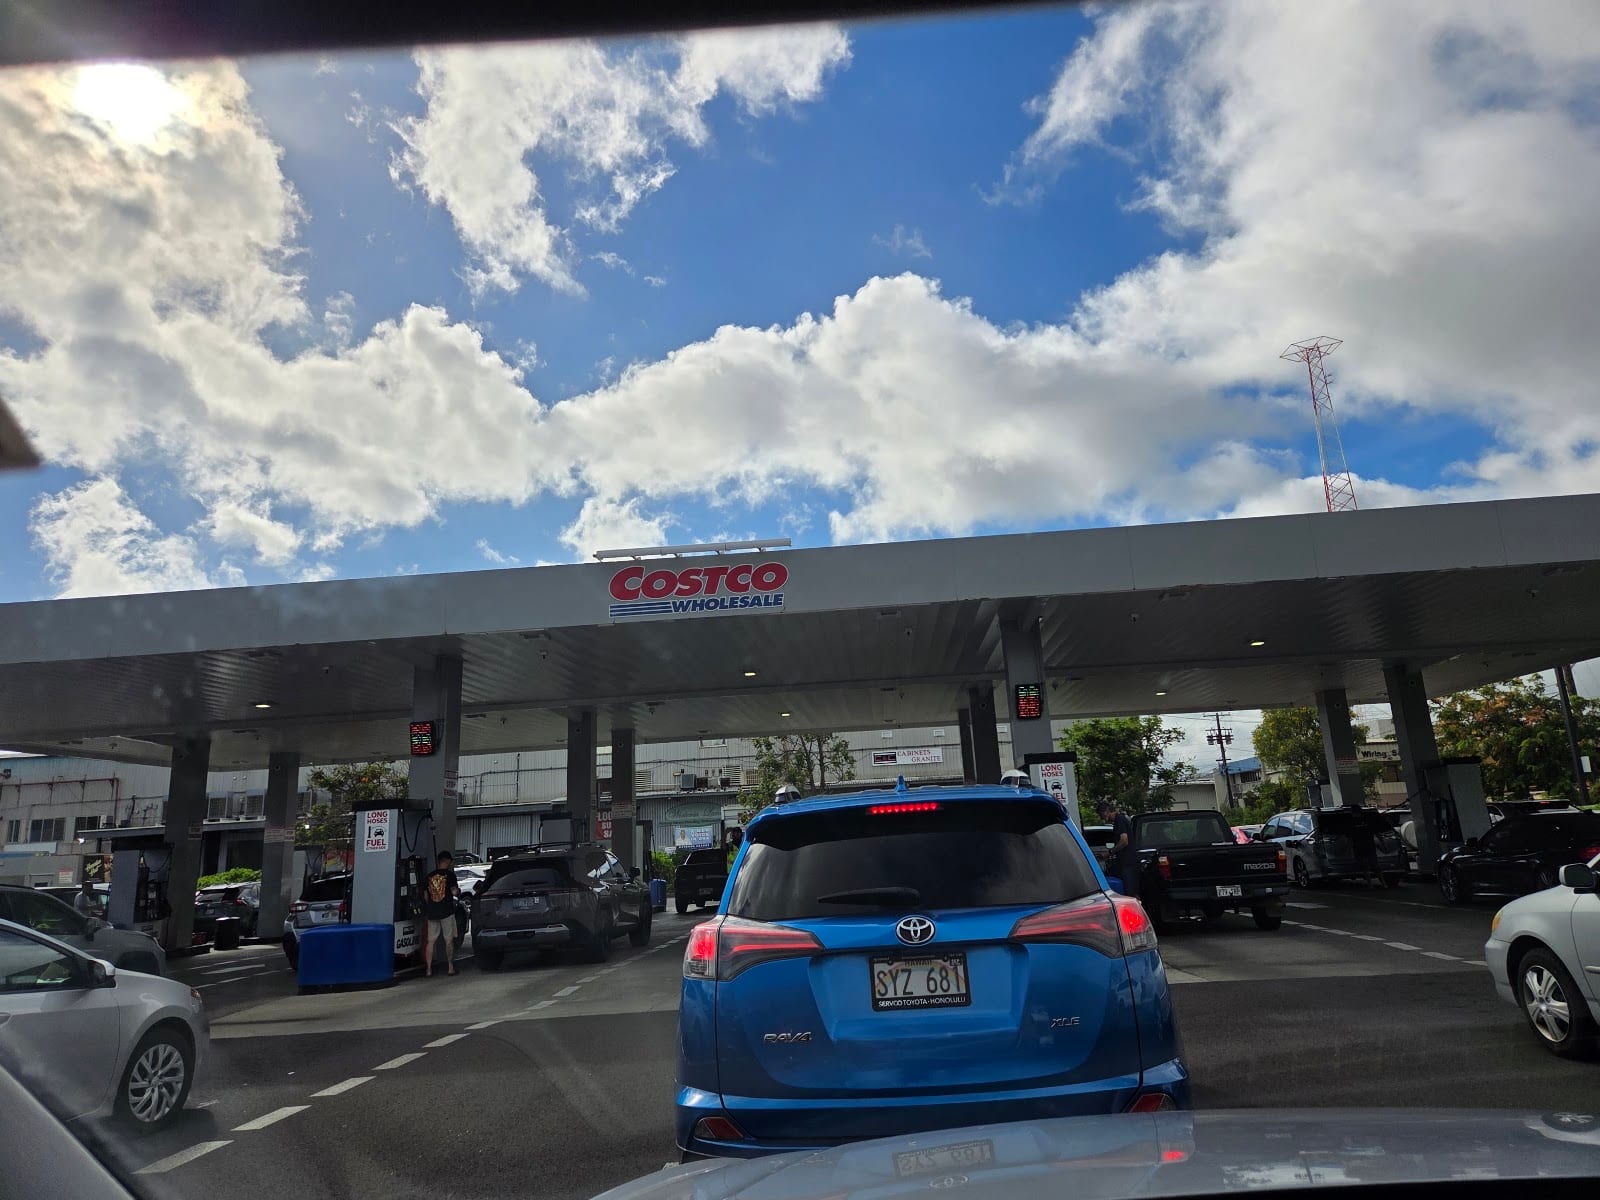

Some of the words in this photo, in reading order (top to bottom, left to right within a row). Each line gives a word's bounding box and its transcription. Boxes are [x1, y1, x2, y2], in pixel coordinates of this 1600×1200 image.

[609, 562, 789, 601] COSTCO
[671, 593, 784, 613] WHOLESALE
[897, 749, 931, 757] CABINETS
[1361, 750, 1387, 759] Wiring
[911, 755, 941, 763] GRANITE
[1041, 764, 1063, 772] LONG
[367, 811, 388, 819] LONG
[366, 839, 387, 847] FUEL
[876, 968, 914, 997] SYZ
[926, 966, 961, 994] 681
[902, 998, 928, 1006] TOYOTA
[930, 996, 966, 1005] HONOLULU
[1050, 1016, 1081, 1028] XLE
[763, 1031, 812, 1043] RAV4
